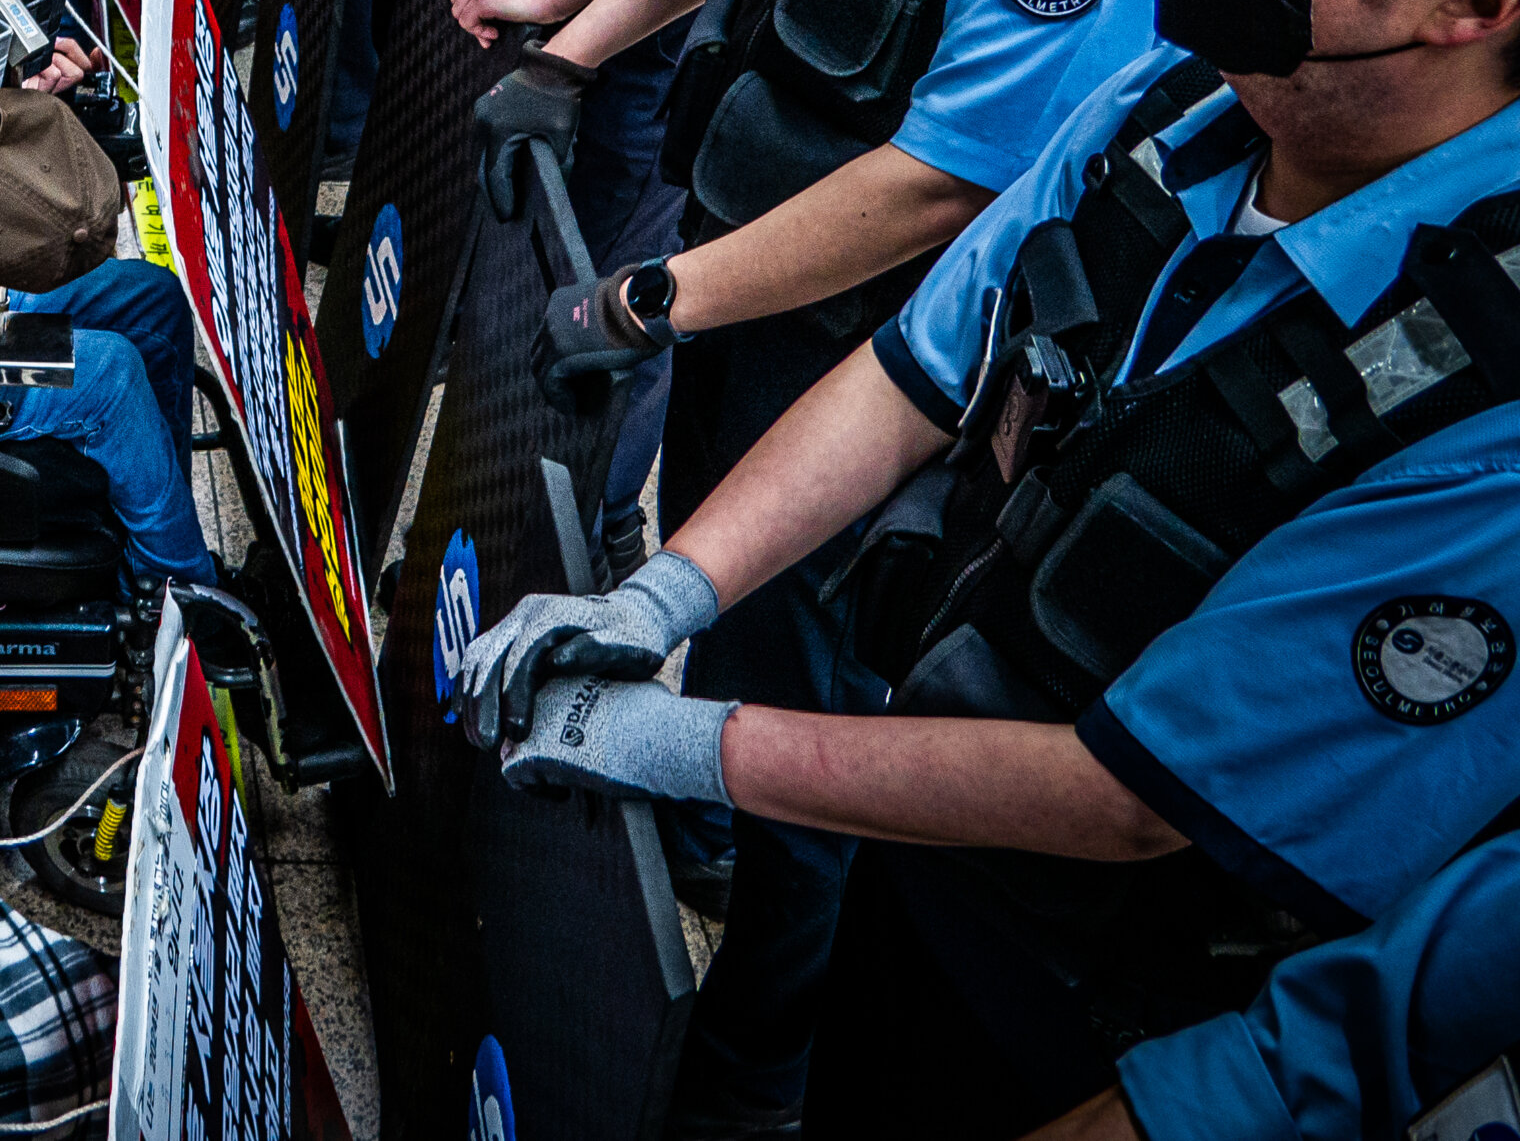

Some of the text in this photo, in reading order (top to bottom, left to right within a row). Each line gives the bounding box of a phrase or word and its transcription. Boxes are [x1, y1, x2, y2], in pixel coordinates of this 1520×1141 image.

[223, 45, 242, 126] 폐지
[241, 101, 255, 195] 폐지
[202, 188, 237, 385] 오세훈
[260, 288, 279, 428] 505명
[286, 328, 318, 540] 해고는
[300, 338, 351, 645] 살인이다!
[167, 857, 186, 978] 입니다.
[189, 735, 222, 1104] 서울시장
[227, 788, 247, 931] 폐지
[246, 860, 262, 1005] 폐지
